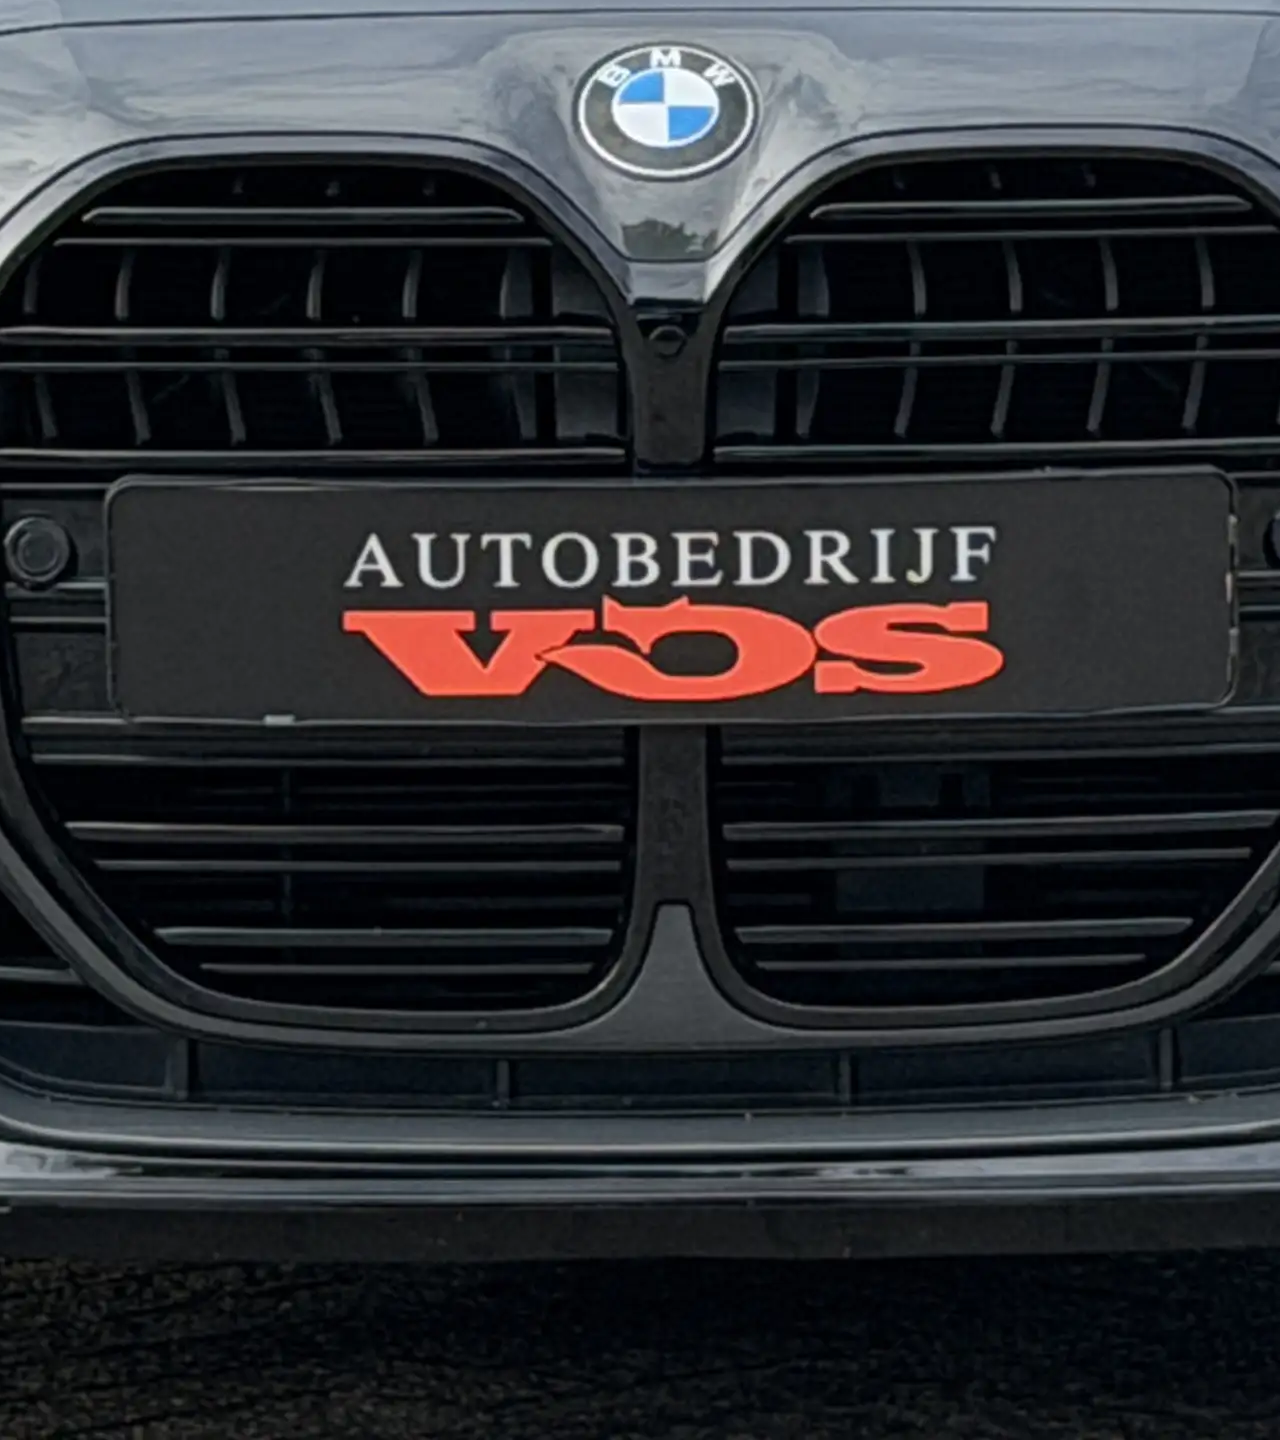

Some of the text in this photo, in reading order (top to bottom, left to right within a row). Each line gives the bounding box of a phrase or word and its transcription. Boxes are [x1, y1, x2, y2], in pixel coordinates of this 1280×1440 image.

[596, 47, 735, 88] BMW
[343, 526, 997, 588] AUTOBEDRIJF
[342, 594, 1004, 701] VOS
